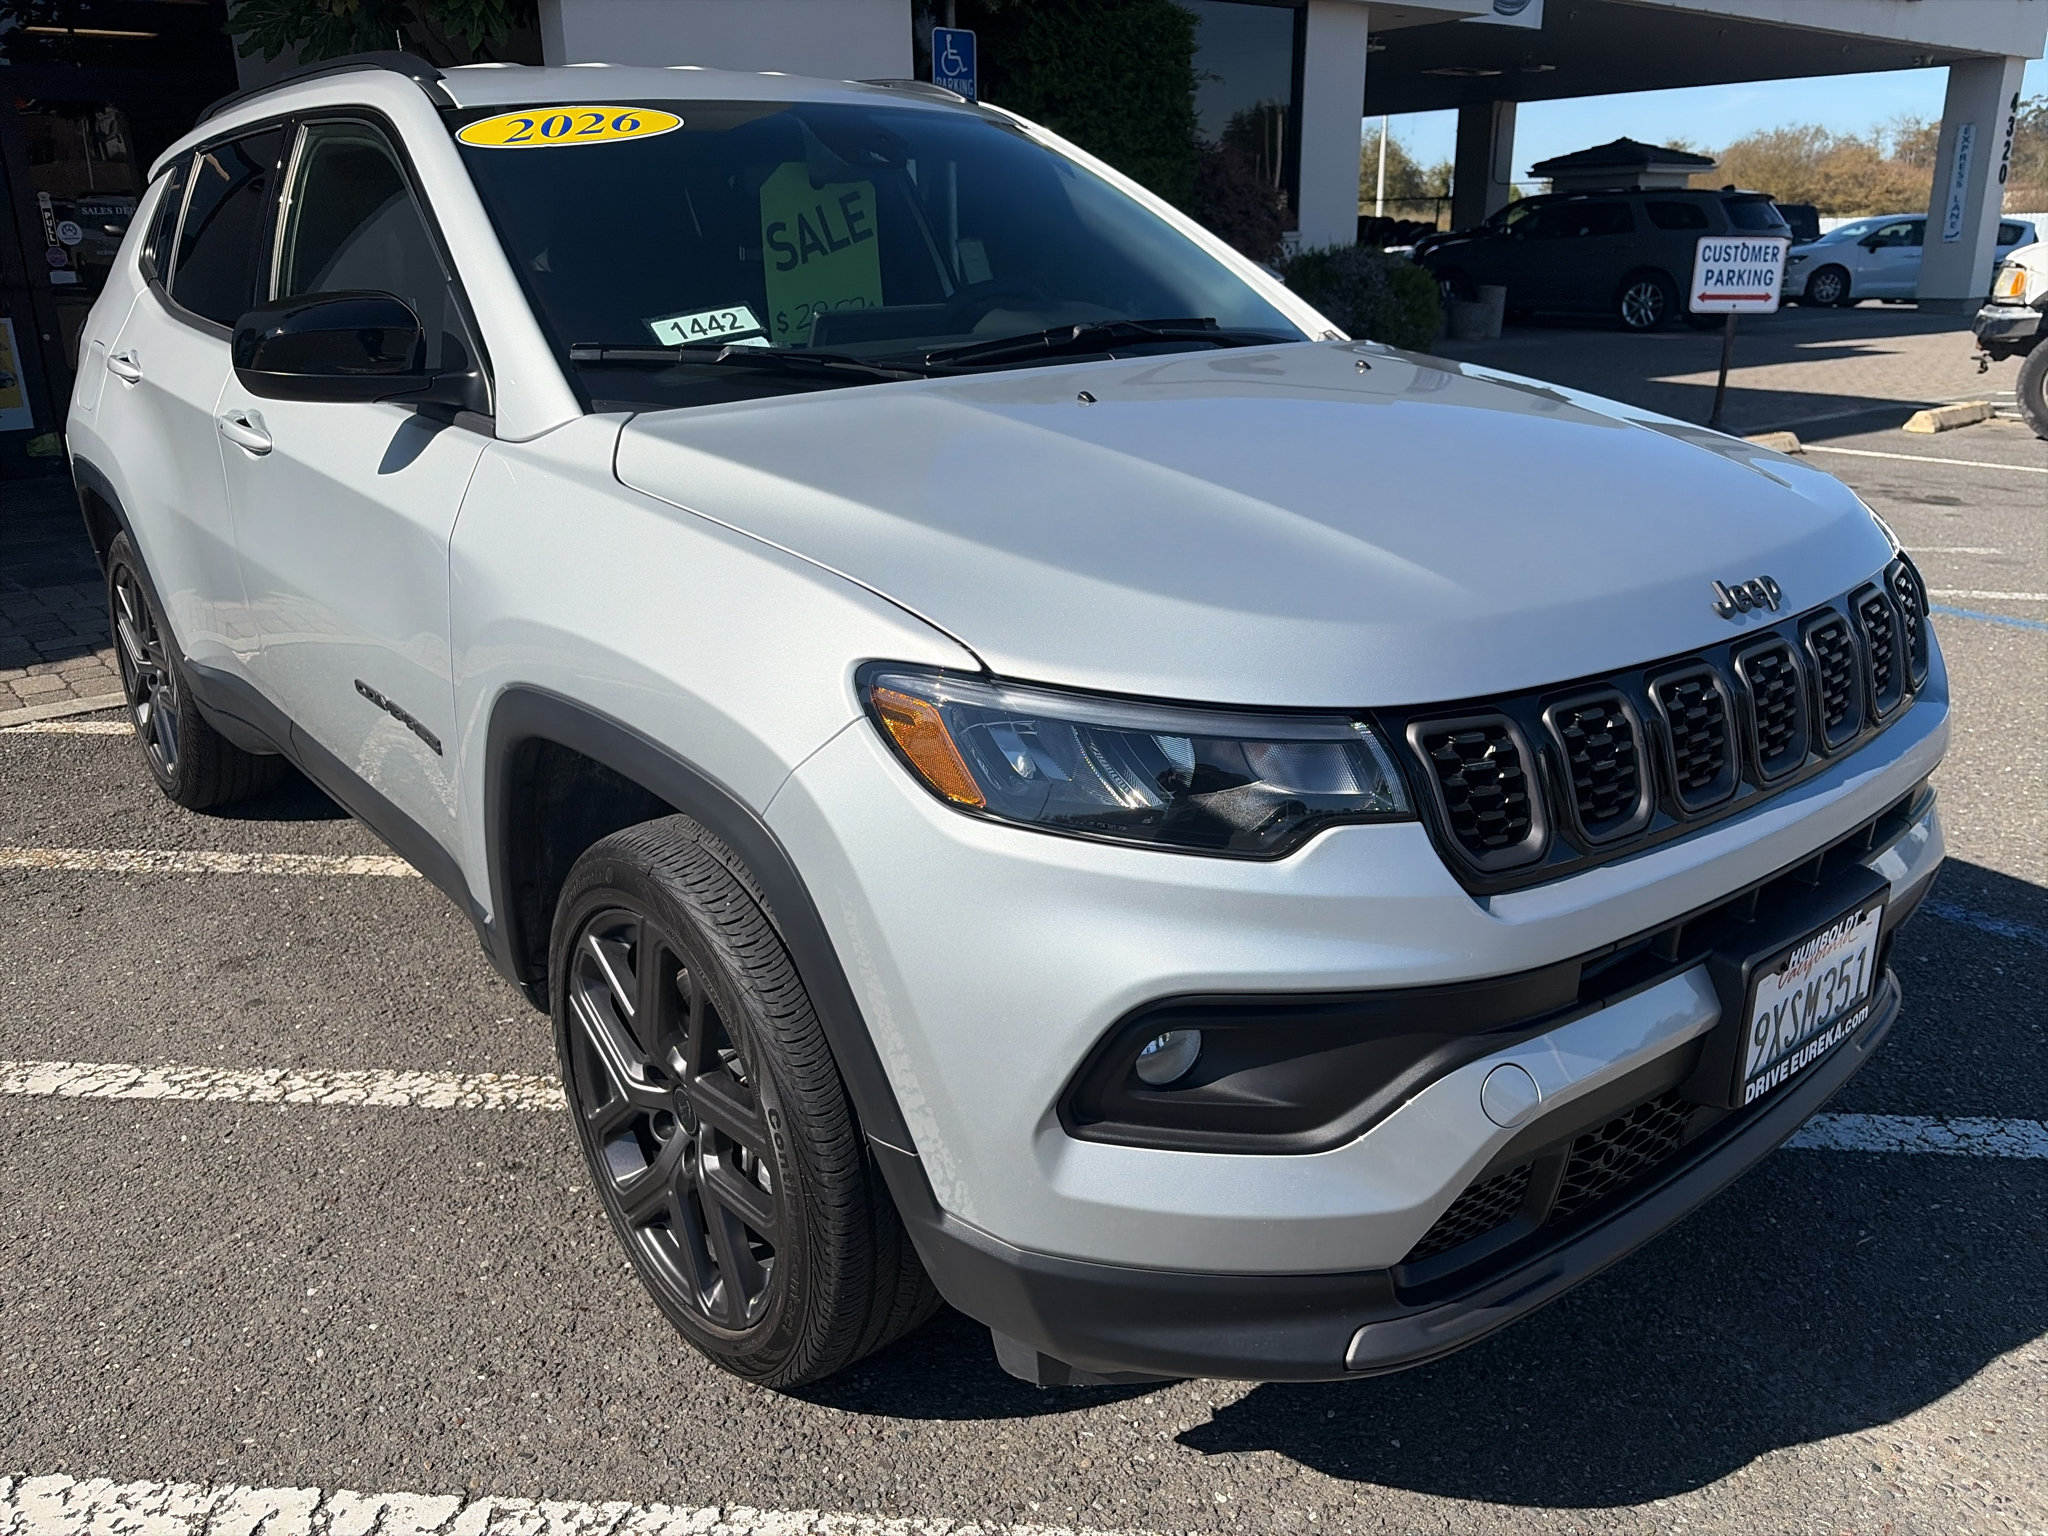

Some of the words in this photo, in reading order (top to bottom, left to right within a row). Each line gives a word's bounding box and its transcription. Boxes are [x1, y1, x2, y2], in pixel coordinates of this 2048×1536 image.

[502, 110, 641, 143] 2026
[1998, 92, 2019, 184] 4320
[1955, 126, 1971, 188] EXPRESS
[44, 211, 56, 242] PULL
[81, 207, 113, 216] SALES
[1949, 195, 1960, 229] LANE
[766, 191, 874, 271] SALE
[1702, 245, 1780, 263] CUSTOMER
[1704, 269, 1775, 287] PARKING
[670, 312, 745, 339] 1442
[1711, 575, 1782, 620] Jeep
[1788, 909, 1863, 969] HUMBOLDT
[1750, 946, 1867, 1076] 9XSM351
